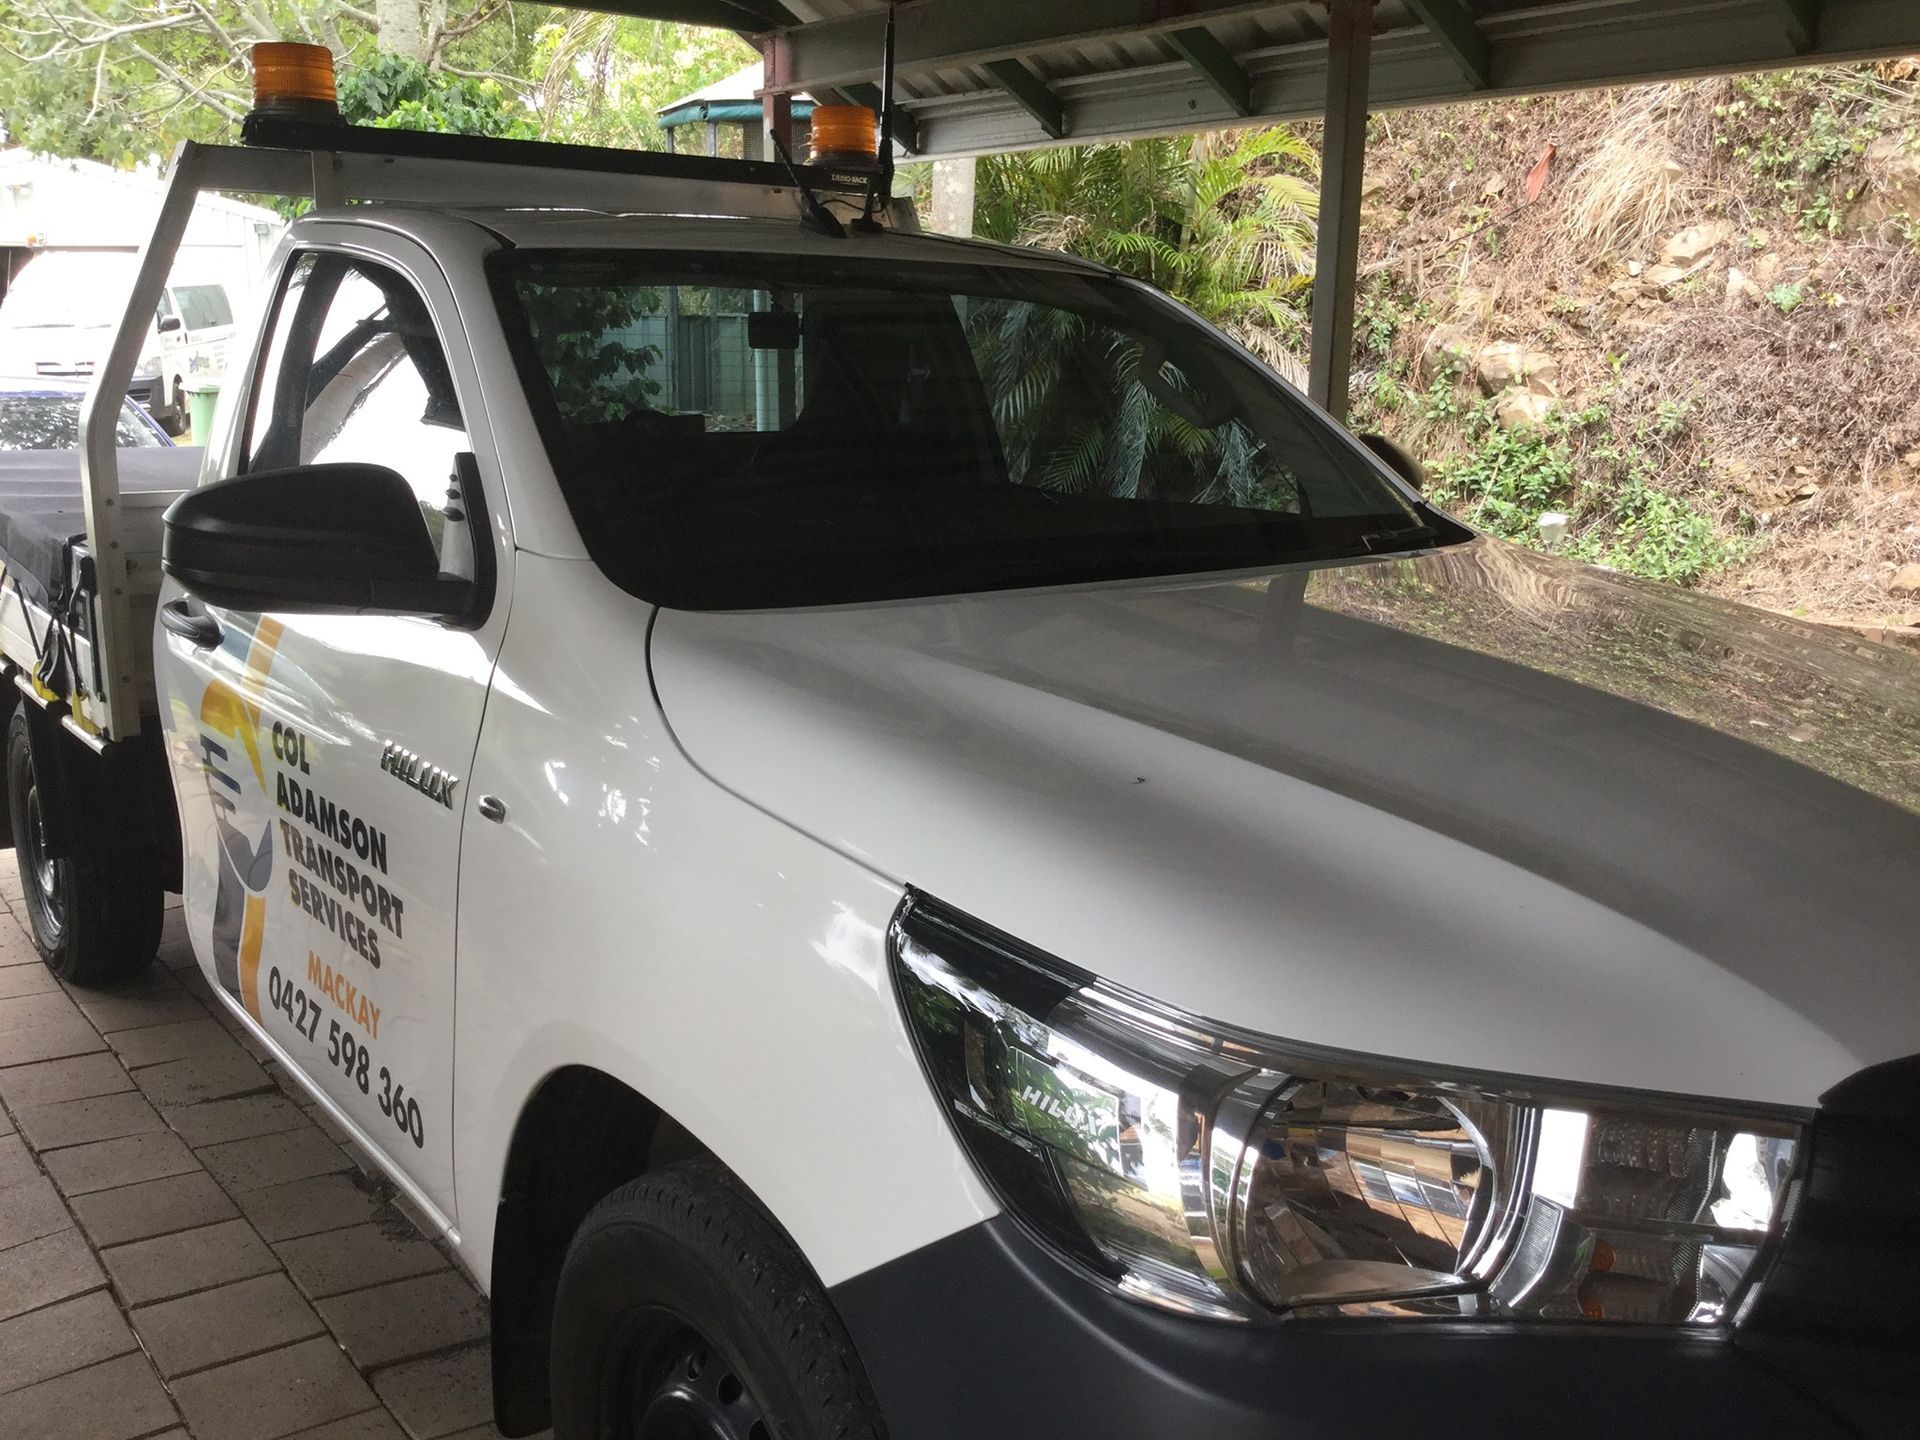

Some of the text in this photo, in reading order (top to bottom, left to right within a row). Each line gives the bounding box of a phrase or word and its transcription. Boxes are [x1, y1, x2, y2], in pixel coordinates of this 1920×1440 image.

[272, 721, 310, 775] COL
[380, 739, 460, 810] HILUX
[276, 771, 388, 875] ADAMSON
[280, 818, 404, 939] TRANSPORT
[288, 868, 381, 970] SERVICES
[307, 950, 381, 1040] MACKAY
[268, 966, 424, 1149] 0427 598 360
